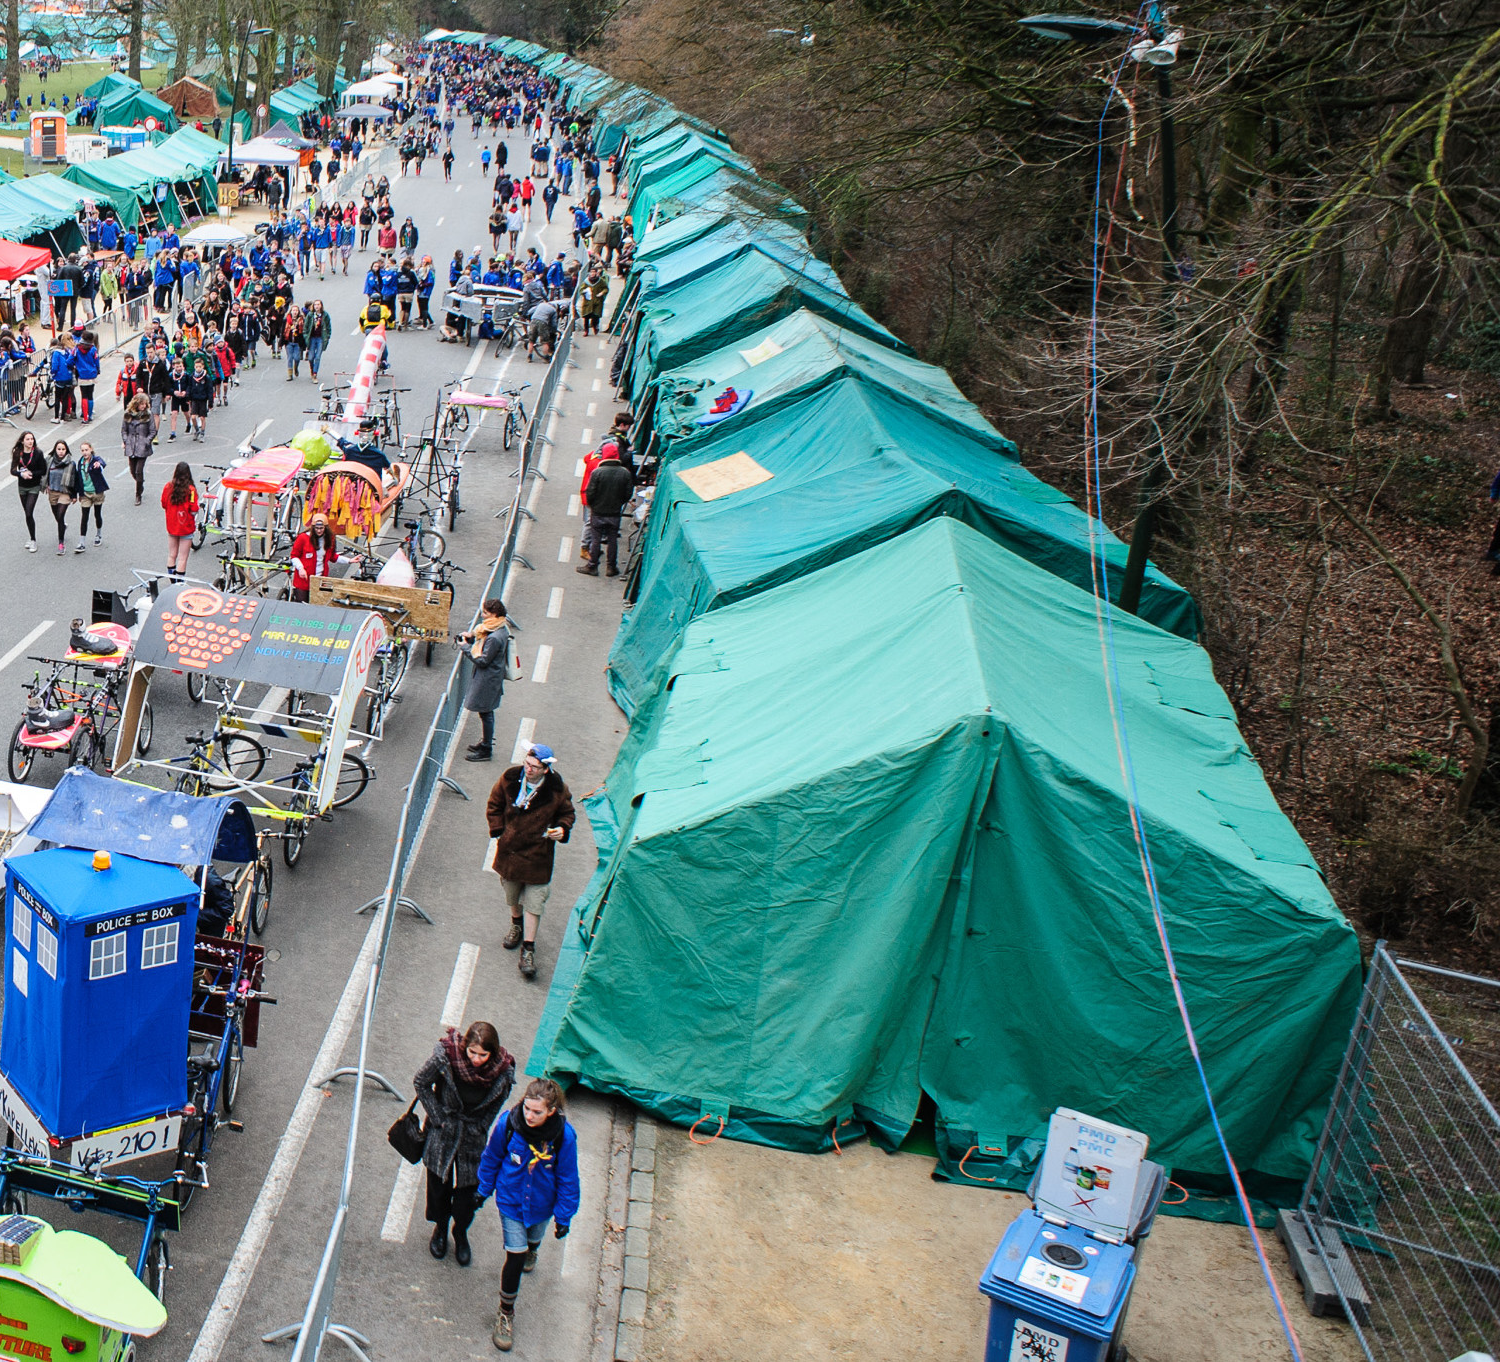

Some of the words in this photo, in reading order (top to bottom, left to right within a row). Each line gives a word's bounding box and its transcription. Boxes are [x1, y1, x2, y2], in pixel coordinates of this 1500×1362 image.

[96, 915, 132, 934] POLICE
[151, 906, 174, 921] BOX
[116, 1130, 157, 1159] 210
[1078, 1125, 1117, 1144] PMD
[1076, 1139, 1115, 1158] PMC
